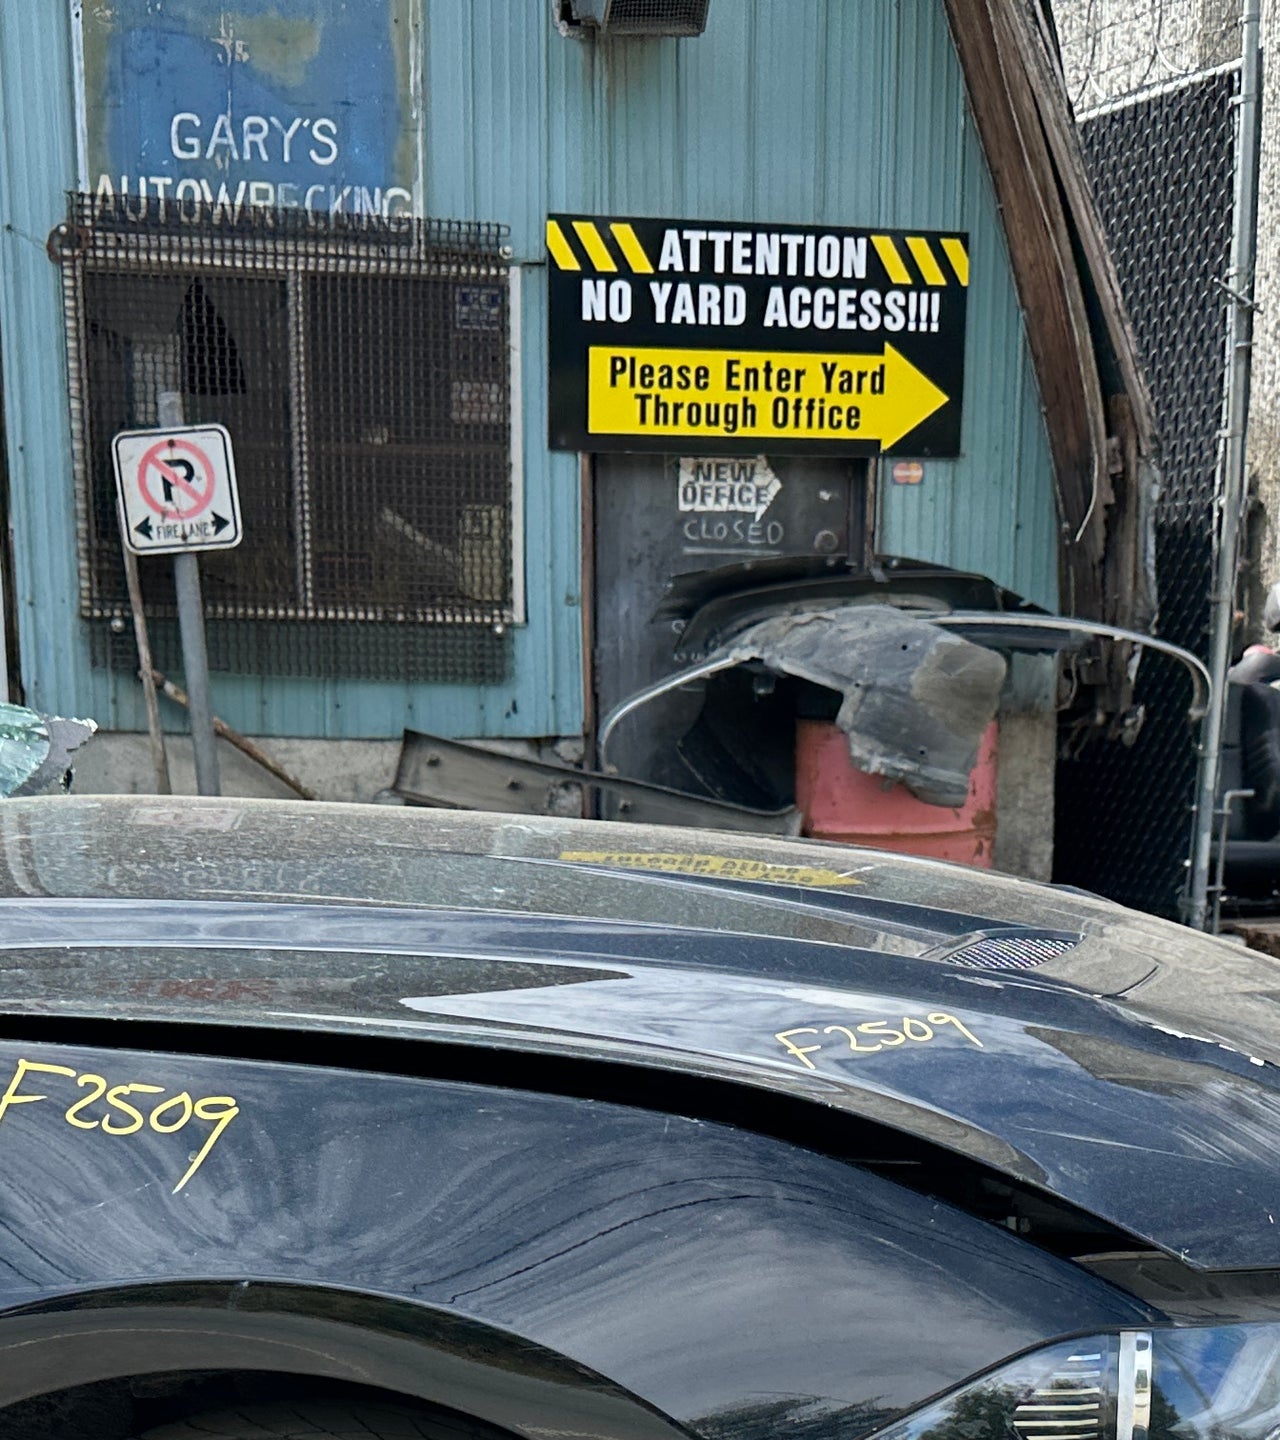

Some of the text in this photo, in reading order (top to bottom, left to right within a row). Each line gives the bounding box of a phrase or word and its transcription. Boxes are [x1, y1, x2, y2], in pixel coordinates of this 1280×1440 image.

[170, 113, 339, 165] GARY'S
[94, 174, 413, 233] AUTOWRECKING
[659, 229, 868, 278] ATTENTION
[582, 279, 941, 332] NO YARD ACCESS!!!
[610, 356, 886, 395] Please Enter Yard
[634, 393, 861, 433] Through Office
[691, 462, 756, 483] NEW
[681, 484, 769, 507] OFFICE
[683, 518, 784, 545] CLOSED
[774, 1012, 984, 1070] F2509
